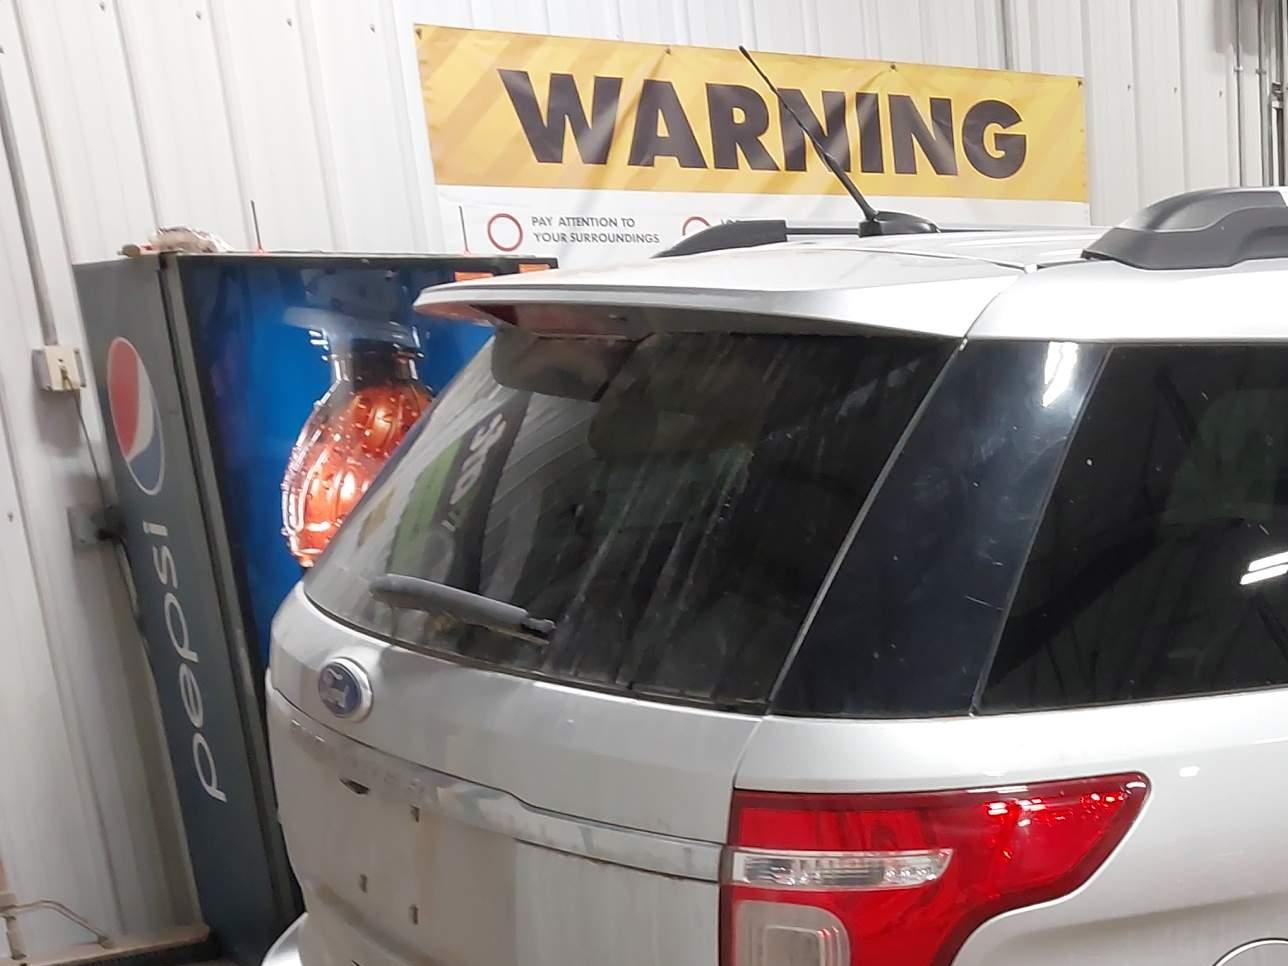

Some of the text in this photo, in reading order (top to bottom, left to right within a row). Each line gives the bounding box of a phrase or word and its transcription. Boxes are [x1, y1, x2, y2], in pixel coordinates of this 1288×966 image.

[498, 69, 1027, 180] WARNING
[531, 216, 636, 228] PAY ATTENTION TO
[533, 231, 660, 244] YOUR SURROUNDINGS
[142, 519, 228, 803] pepsi
